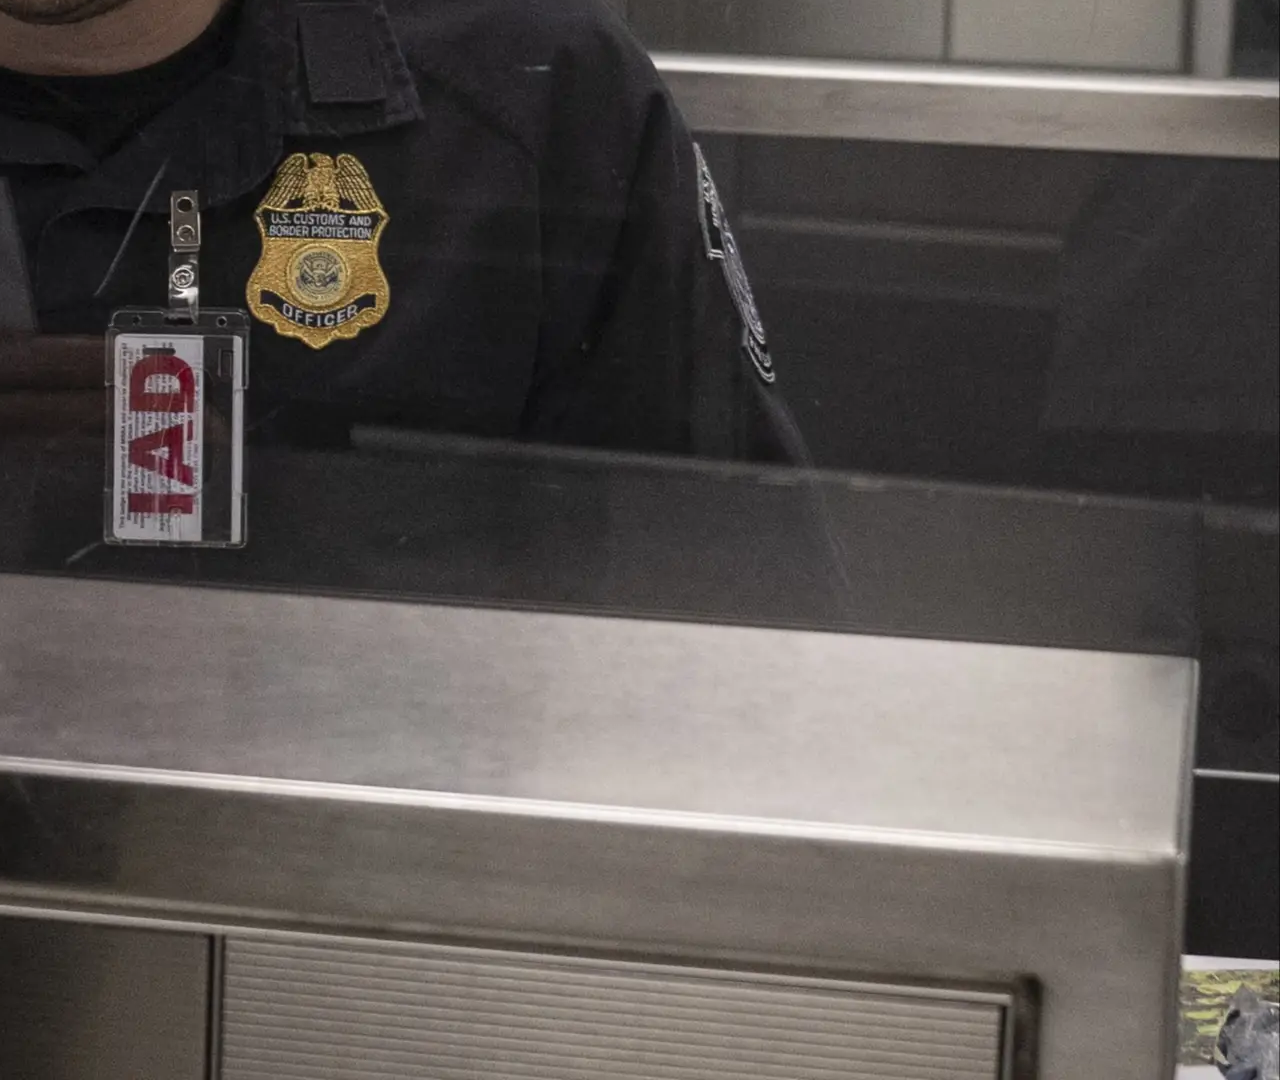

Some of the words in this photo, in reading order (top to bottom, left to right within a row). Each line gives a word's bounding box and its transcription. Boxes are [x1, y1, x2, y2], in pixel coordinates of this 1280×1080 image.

[271, 213, 290, 224] U.S.
[293, 213, 344, 226] CUSTOMS
[349, 215, 372, 226] AND
[269, 225, 309, 237] BORDER
[311, 226, 372, 239] PROTECTION
[282, 302, 359, 327] OFFICER
[128, 354, 195, 514] IAD
